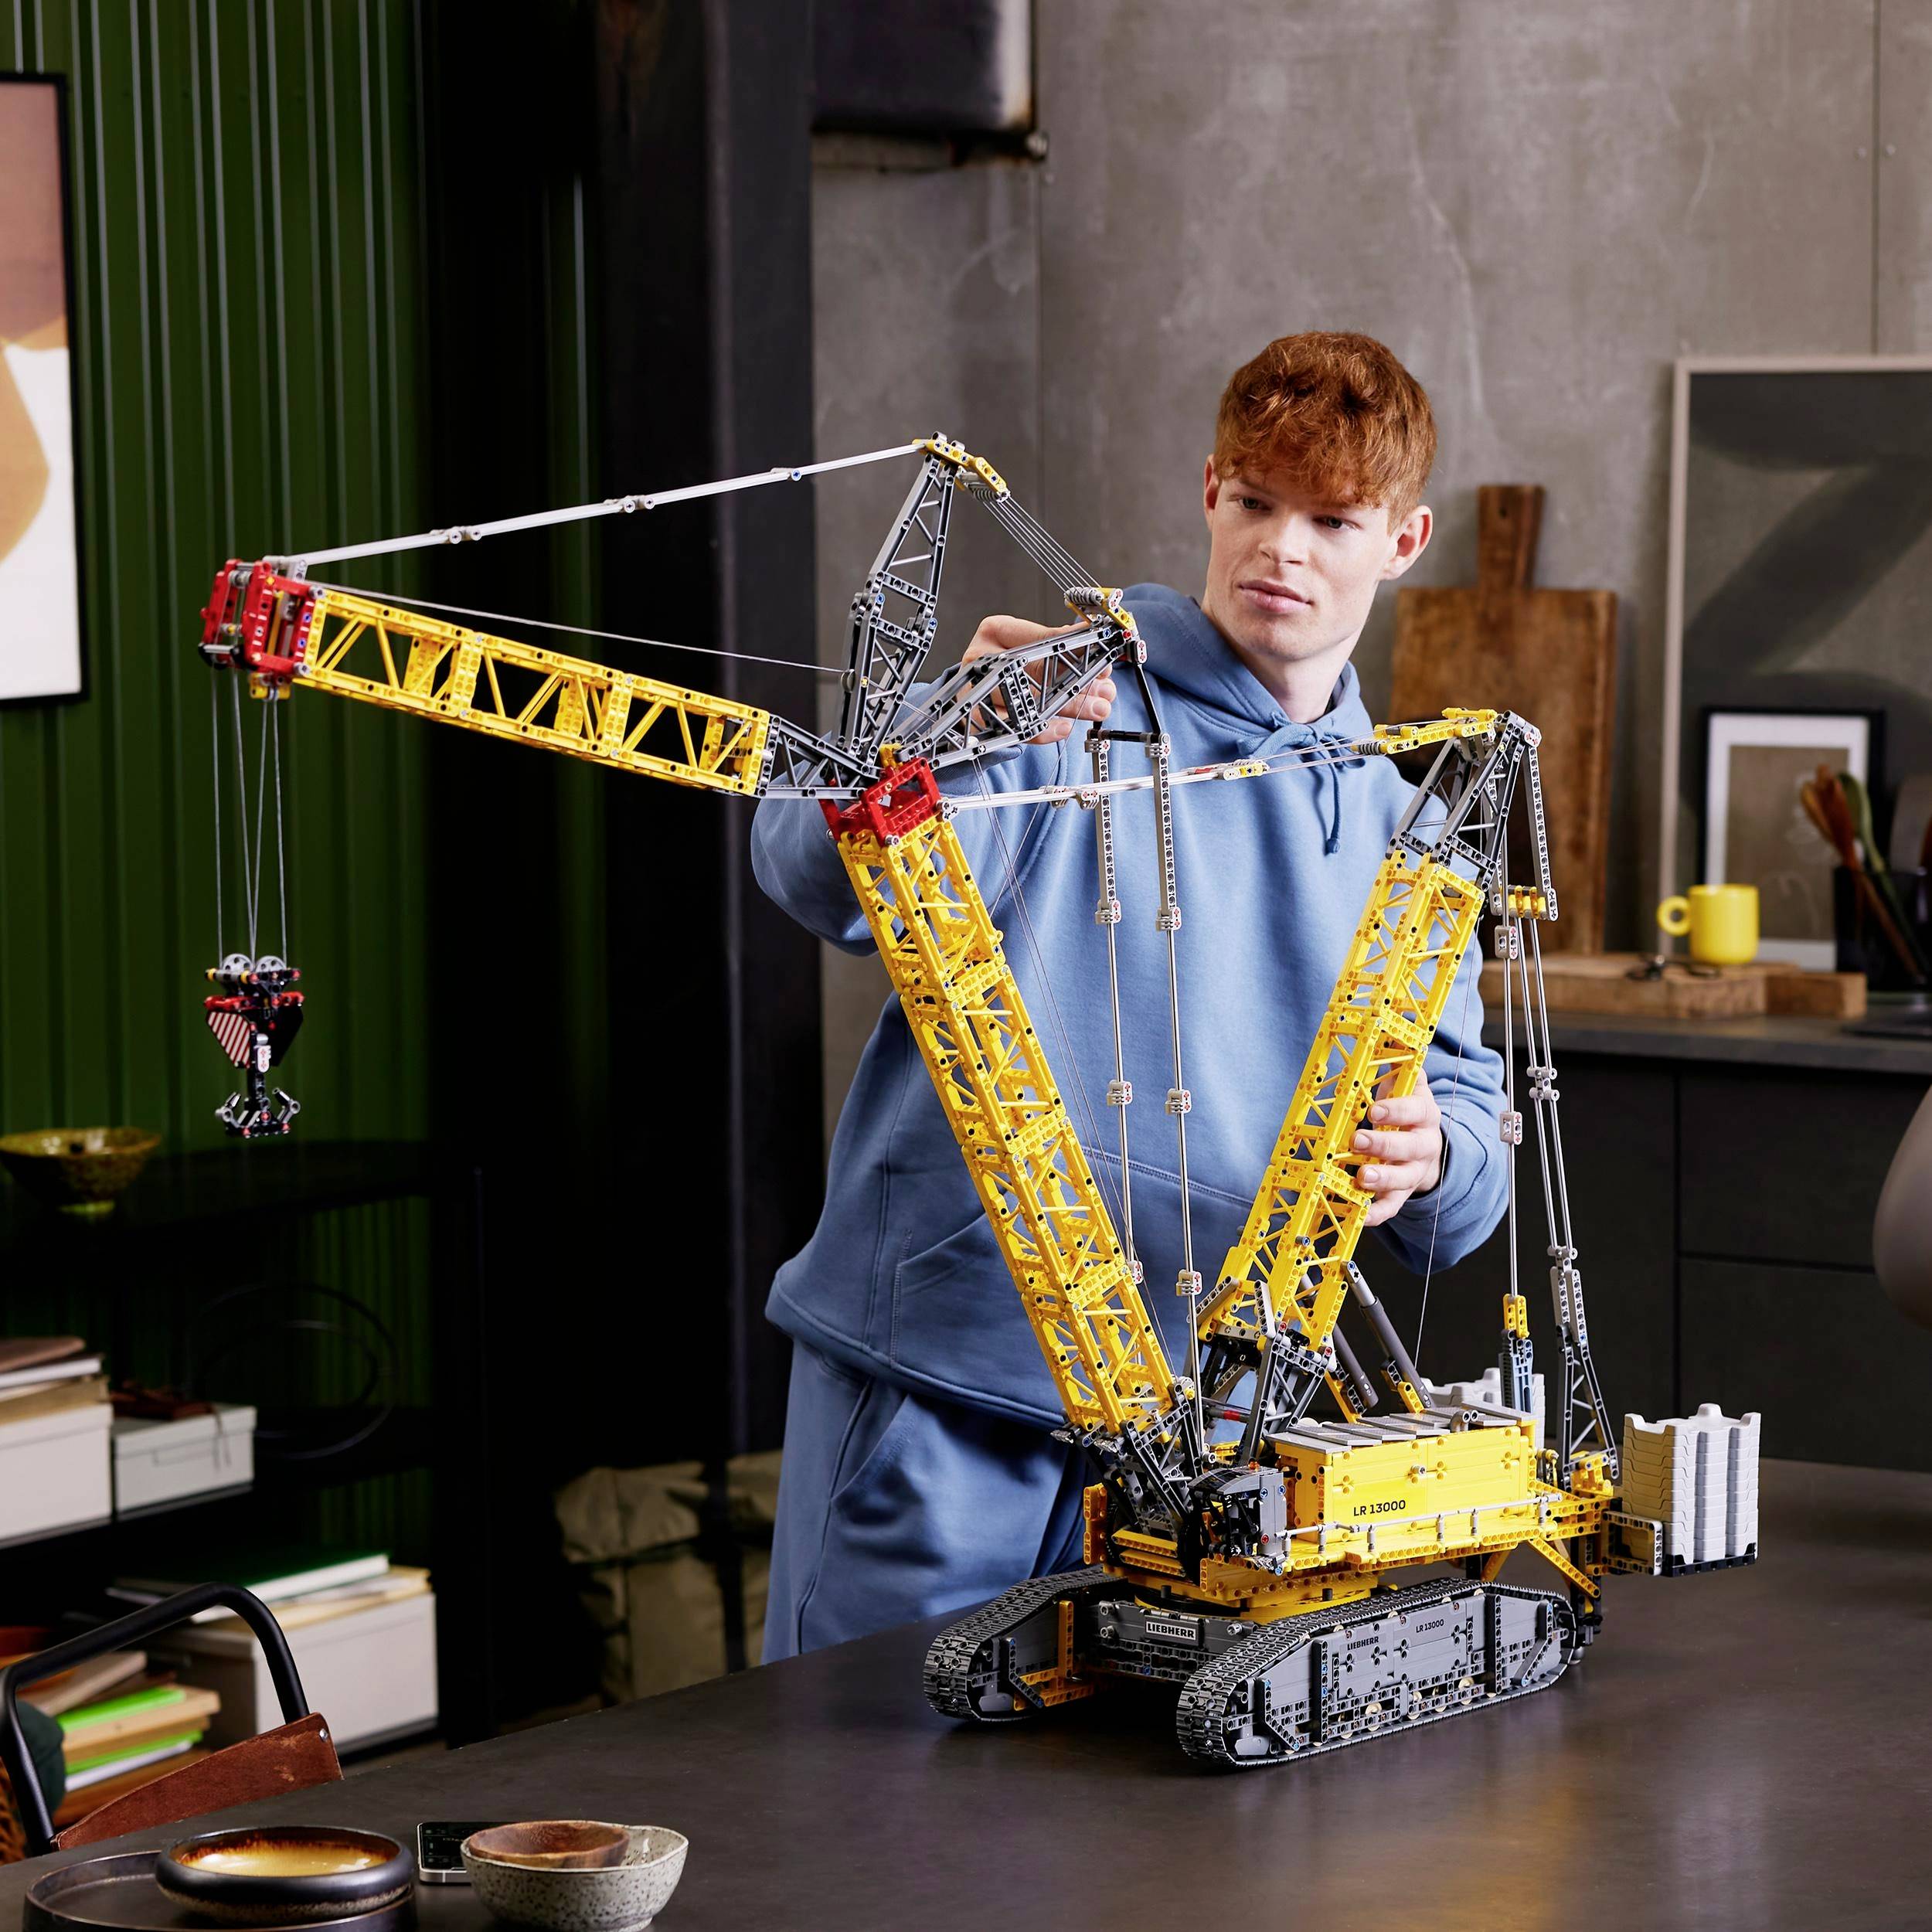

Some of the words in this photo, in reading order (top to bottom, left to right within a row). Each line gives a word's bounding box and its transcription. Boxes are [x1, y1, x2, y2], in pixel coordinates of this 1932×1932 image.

[1354, 1506, 1366, 1516] LR
[1370, 1500, 1406, 1514] 13000
[1148, 1624, 1194, 1638] LIEBHERR
[1416, 1624, 1423, 1633] LR
[1424, 1619, 1444, 1630] 13000
[1347, 1636, 1379, 1651] LIEBHERR
